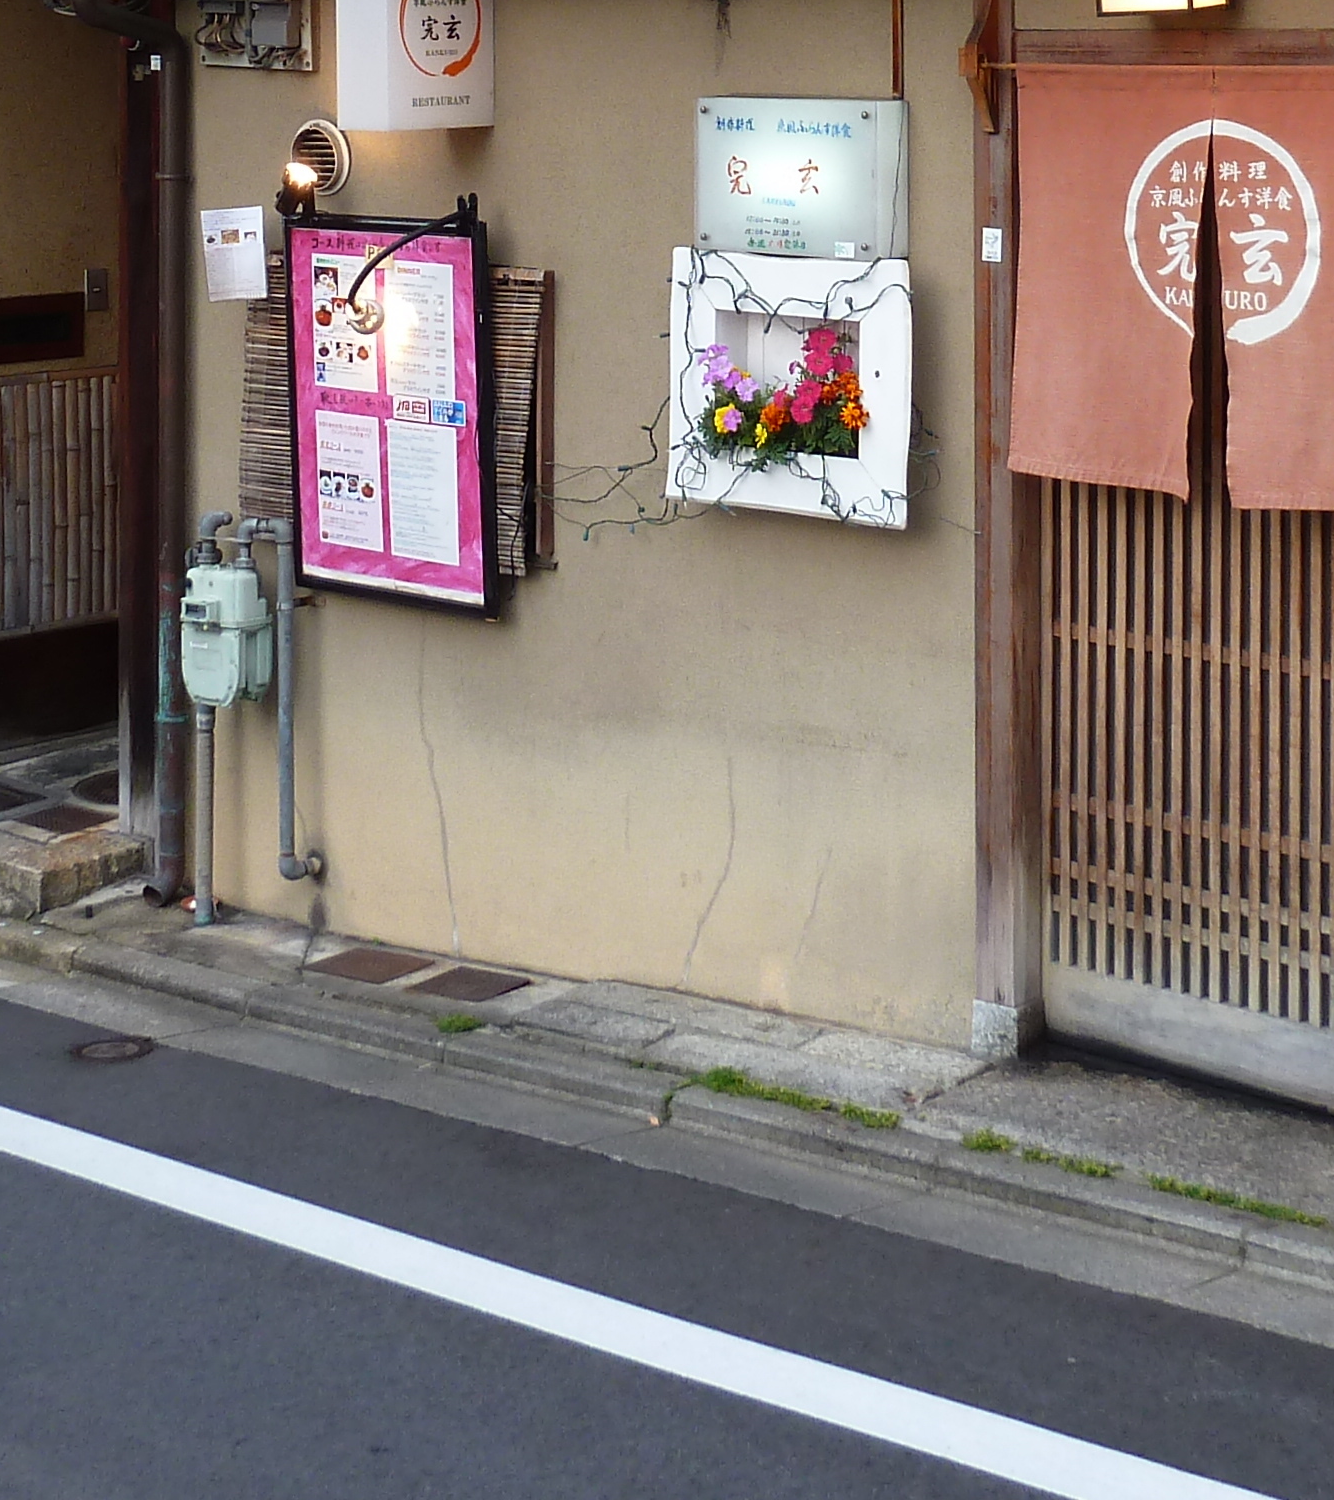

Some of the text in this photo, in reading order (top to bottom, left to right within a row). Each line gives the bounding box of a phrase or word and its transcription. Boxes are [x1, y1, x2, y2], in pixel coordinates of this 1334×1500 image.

[420, 14, 462, 41] 完玄
[411, 95, 471, 108] RESTAURANT
[727, 155, 820, 196] 完玄
[1149, 185, 1294, 211] 京風ふんす洋食
[1165, 286, 1268, 311] KAURO
